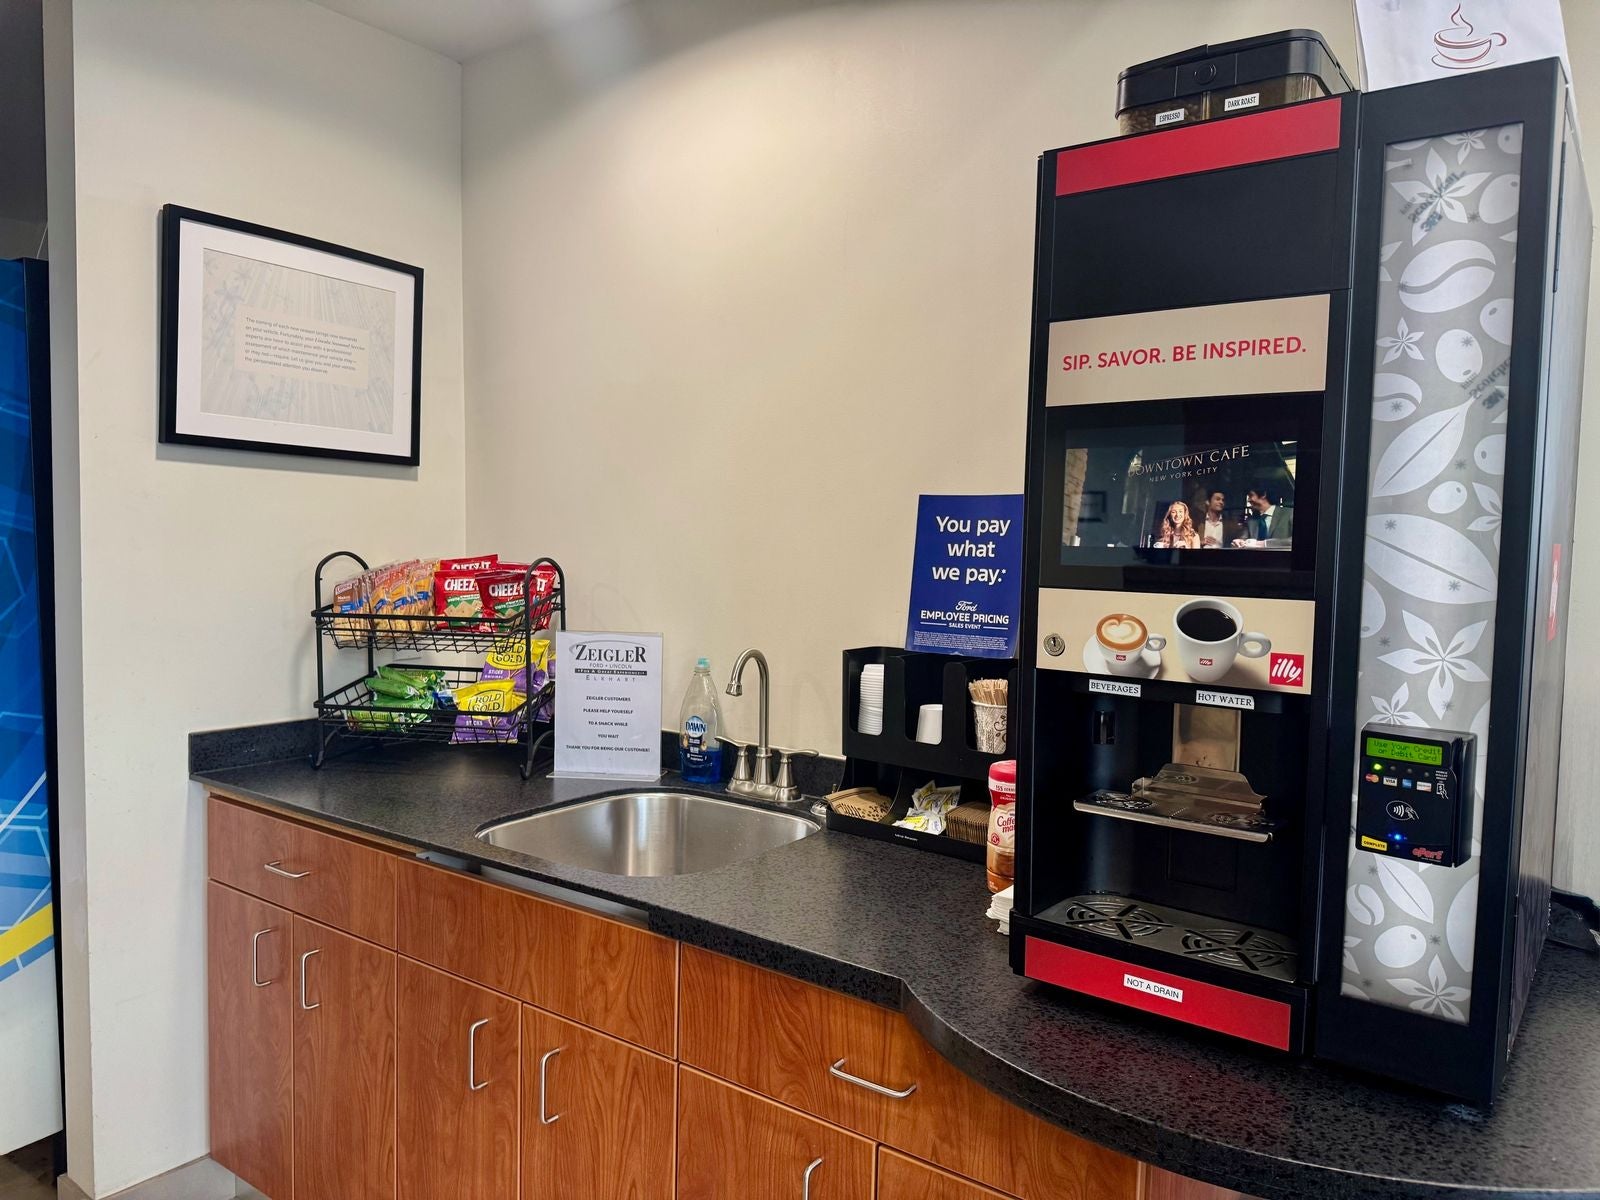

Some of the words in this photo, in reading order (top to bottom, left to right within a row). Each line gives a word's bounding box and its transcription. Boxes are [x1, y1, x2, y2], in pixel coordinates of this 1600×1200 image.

[1228, 98, 1240, 108] DARK
[1241, 96, 1257, 106] ROAST
[1159, 112, 1181, 122] ESPRESSO
[1063, 355, 1092, 370] SIP.
[1097, 348, 1166, 367] SAVOR.
[1173, 345, 1197, 362] BE
[1203, 337, 1307, 360] INSPIRED.
[1170, 471, 1193, 480] YORK
[1196, 466, 1219, 477] CITY
[936, 516, 970, 533] You
[977, 519, 1011, 536] pay
[947, 540, 995, 557] what
[932, 567, 960, 580] we
[955, 600, 978, 612] Ford
[920, 610, 970, 622] EMPLOYEE
[972, 613, 1009, 625] PRICING
[496, 653, 523, 663] GOLD
[575, 644, 647, 664] ZEIGLER
[1271, 658, 1301, 683] illy
[585, 675, 636, 683] ELKHART
[1090, 682, 1139, 694] BEVERAGES
[475, 693, 502, 704] ROLD
[1198, 693, 1216, 703] HOT
[1219, 694, 1253, 707] WATER
[685, 721, 707, 733] DAWN
[1373, 739, 1388, 747] Use
[1391, 742, 1409, 750] Your
[1414, 745, 1441, 755] Credit
[1417, 753, 1437, 761] Card
[1363, 840, 1386, 850] COMPLETE
[1412, 847, 1443, 859] ePort
[1126, 977, 1144, 988] NOT
[1146, 983, 1152, 991] A
[1153, 985, 1180, 998] DRAIN
